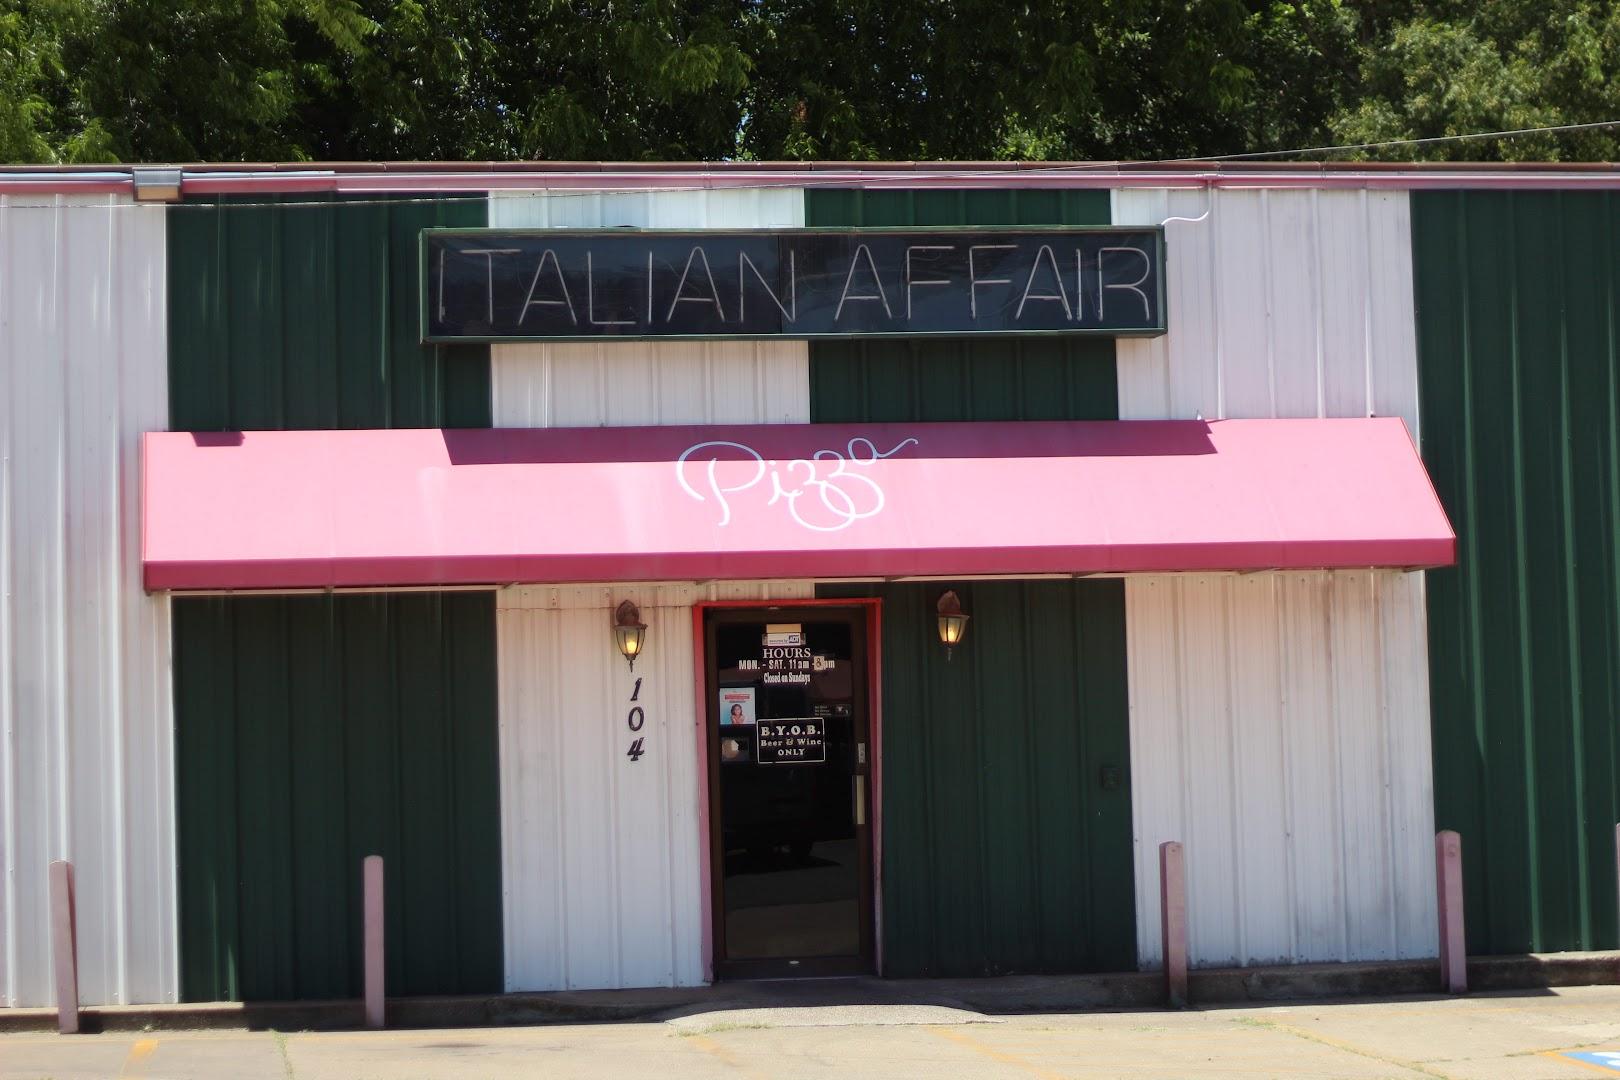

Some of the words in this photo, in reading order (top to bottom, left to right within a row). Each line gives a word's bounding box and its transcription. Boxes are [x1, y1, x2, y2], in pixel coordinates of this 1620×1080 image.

[438, 246, 796, 326] ITALIAN
[834, 244, 1151, 321] AFFAIR
[676, 437, 919, 531] Pizza
[763, 648, 811, 658] HOURS
[738, 660, 760, 670] MON.
[768, 660, 786, 670] SAT.
[763, 672, 781, 683] Closed
[782, 675, 788, 683] on
[788, 672, 811, 685] Sundays
[761, 725, 821, 736] B.Y.O.B.
[786, 738, 794, 746] &
[797, 738, 822, 746] Wine
[777, 748, 805, 756] ONLY
